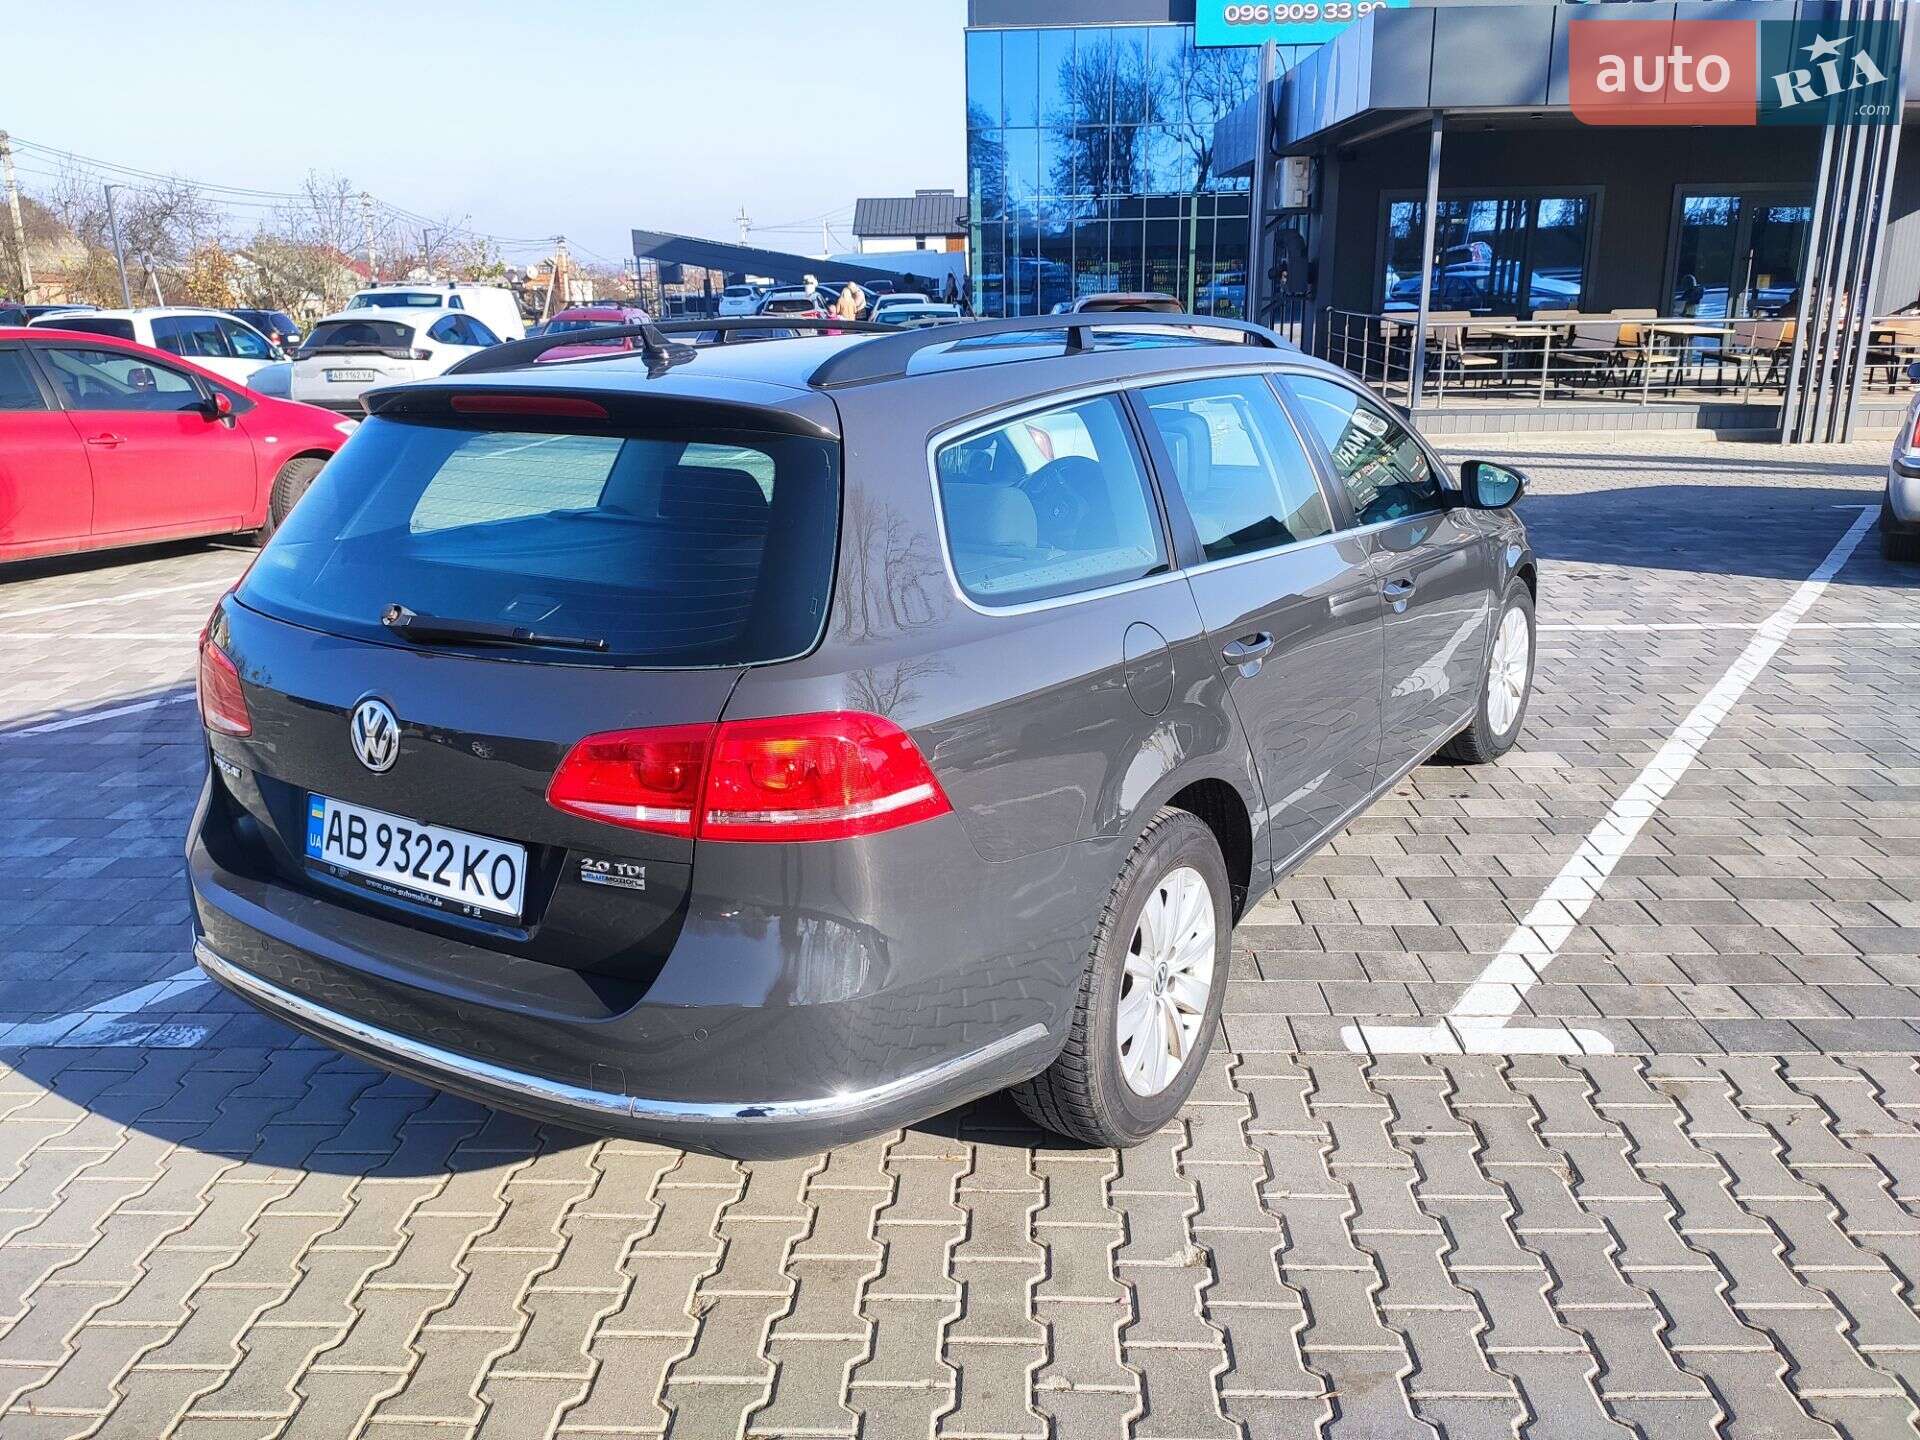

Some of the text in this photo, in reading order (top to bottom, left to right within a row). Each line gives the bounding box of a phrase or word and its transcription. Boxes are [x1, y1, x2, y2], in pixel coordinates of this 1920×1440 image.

[1224, 4, 1270, 22] 096
[1274, 4, 1320, 21] 909
[1324, 2, 1352, 20] 33
[309, 832, 322, 849] UA
[325, 809, 516, 900] AB 9322 KO
[614, 863, 646, 878] TDI
